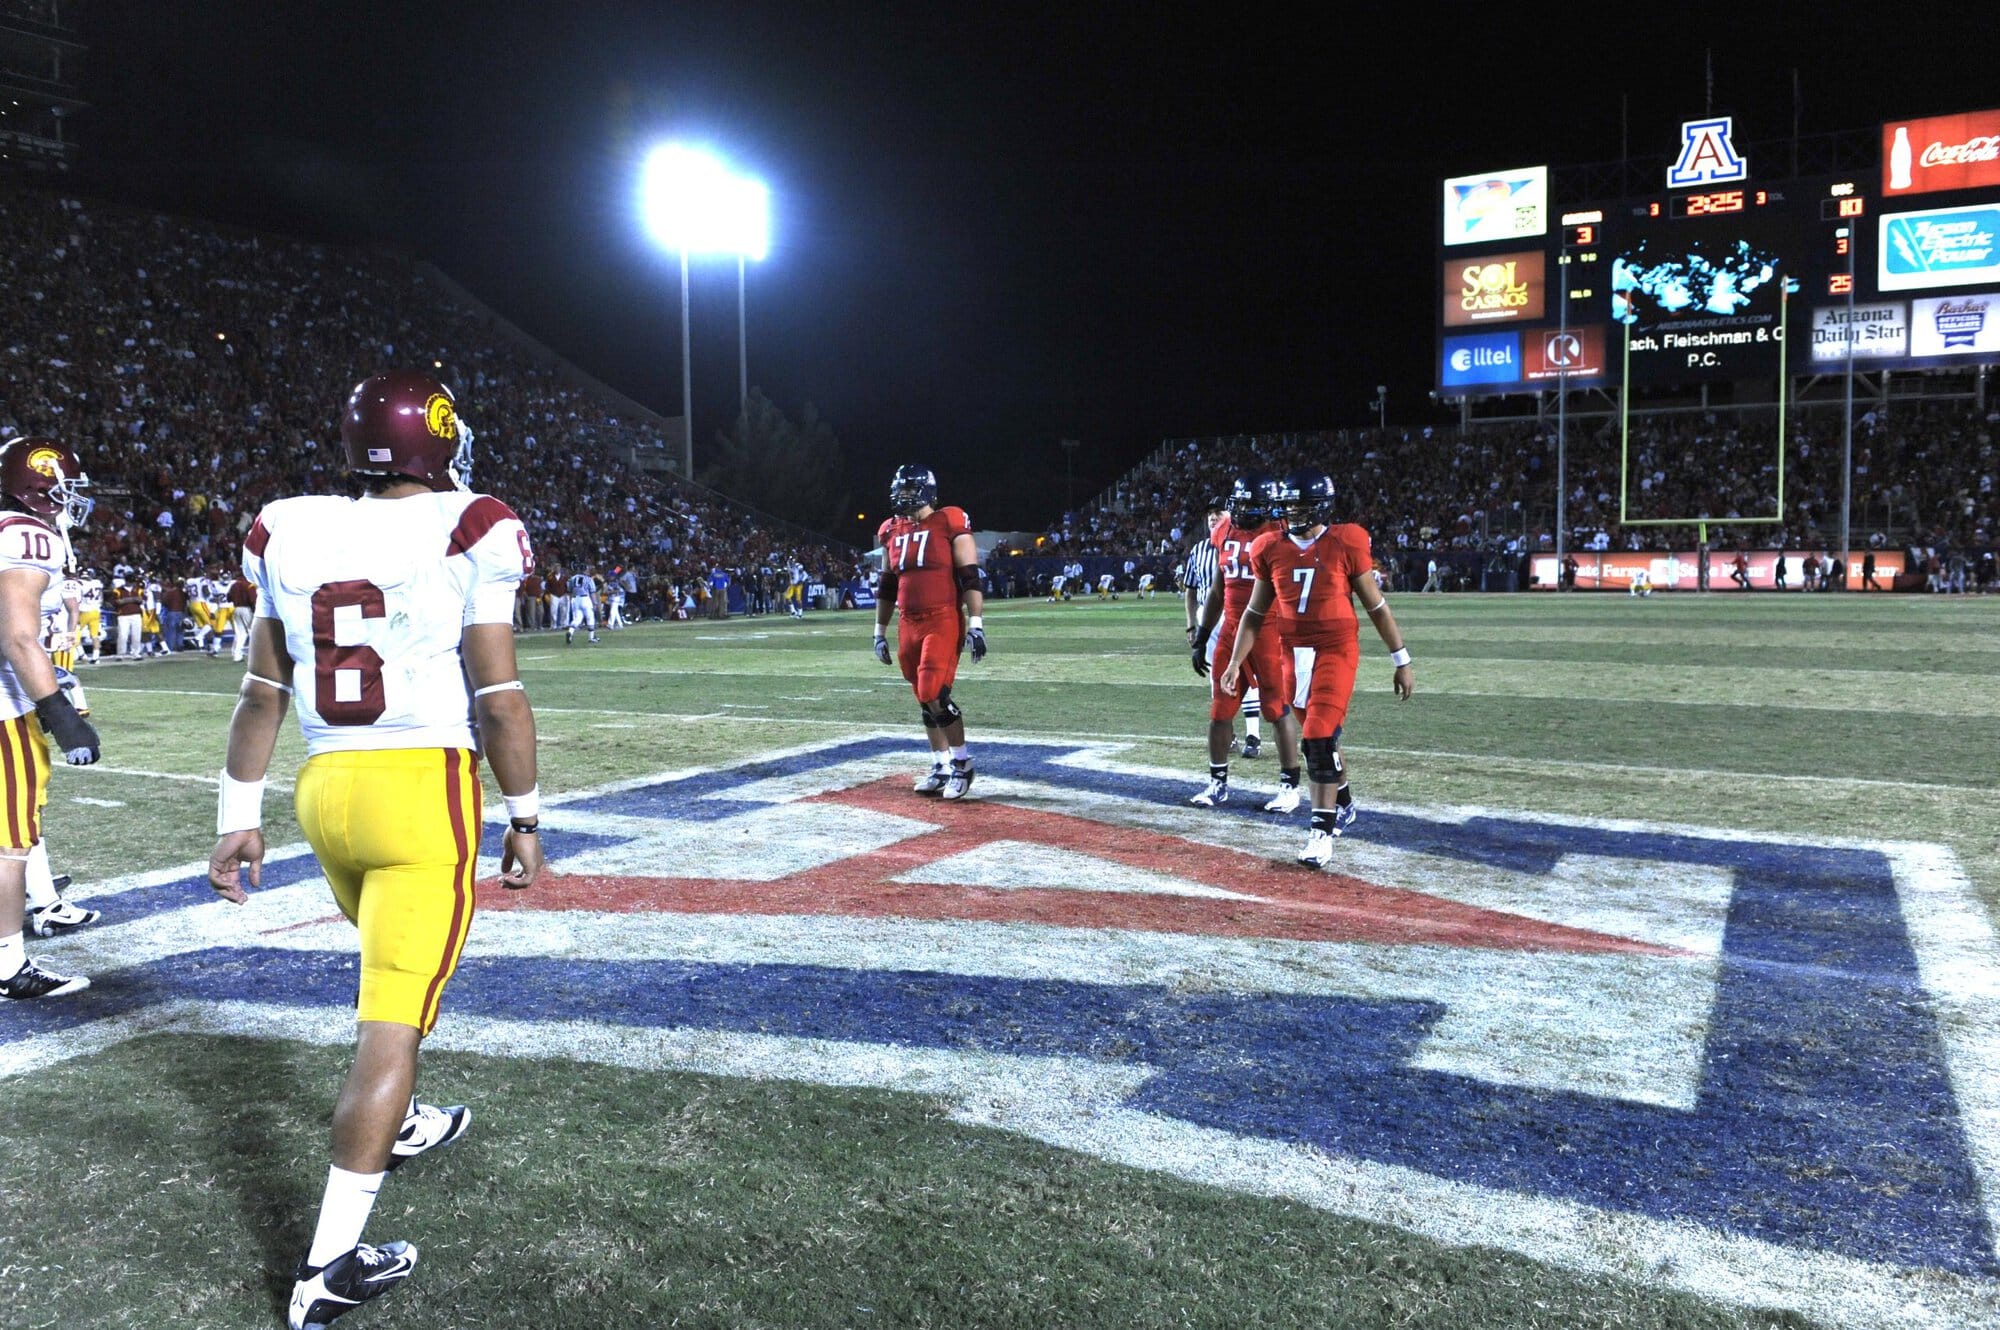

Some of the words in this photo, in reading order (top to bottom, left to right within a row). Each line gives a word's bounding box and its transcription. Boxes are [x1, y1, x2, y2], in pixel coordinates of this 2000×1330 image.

[1667, 116, 1747, 188] A
[1687, 191, 1743, 215] 2:25
[1756, 192, 1766, 204] 3
[1650, 203, 1659, 216] 3
[1840, 198, 1863, 217] 10
[1576, 226, 1592, 244] 3
[1915, 221, 1978, 238] Tucson
[1836, 239, 1848, 254] 3
[1921, 231, 1994, 251] Electric
[1927, 248, 1994, 264] Power
[1462, 261, 1528, 297] SOL
[1829, 275, 1852, 293] 25
[1461, 292, 1528, 310] CASINOS
[1823, 309, 1894, 325] Arizona
[1664, 331, 1752, 348] Fleischman
[1756, 328, 1769, 341] &
[1812, 327, 1860, 344] Daily
[1864, 324, 1904, 340] Star
[1688, 352, 1721, 367] P.C.
[21, 531, 51, 560] 10
[895, 530, 929, 571] 77
[84, 587, 102, 601] 47
[1293, 568, 1315, 614] 7
[311, 578, 386, 726] 6
